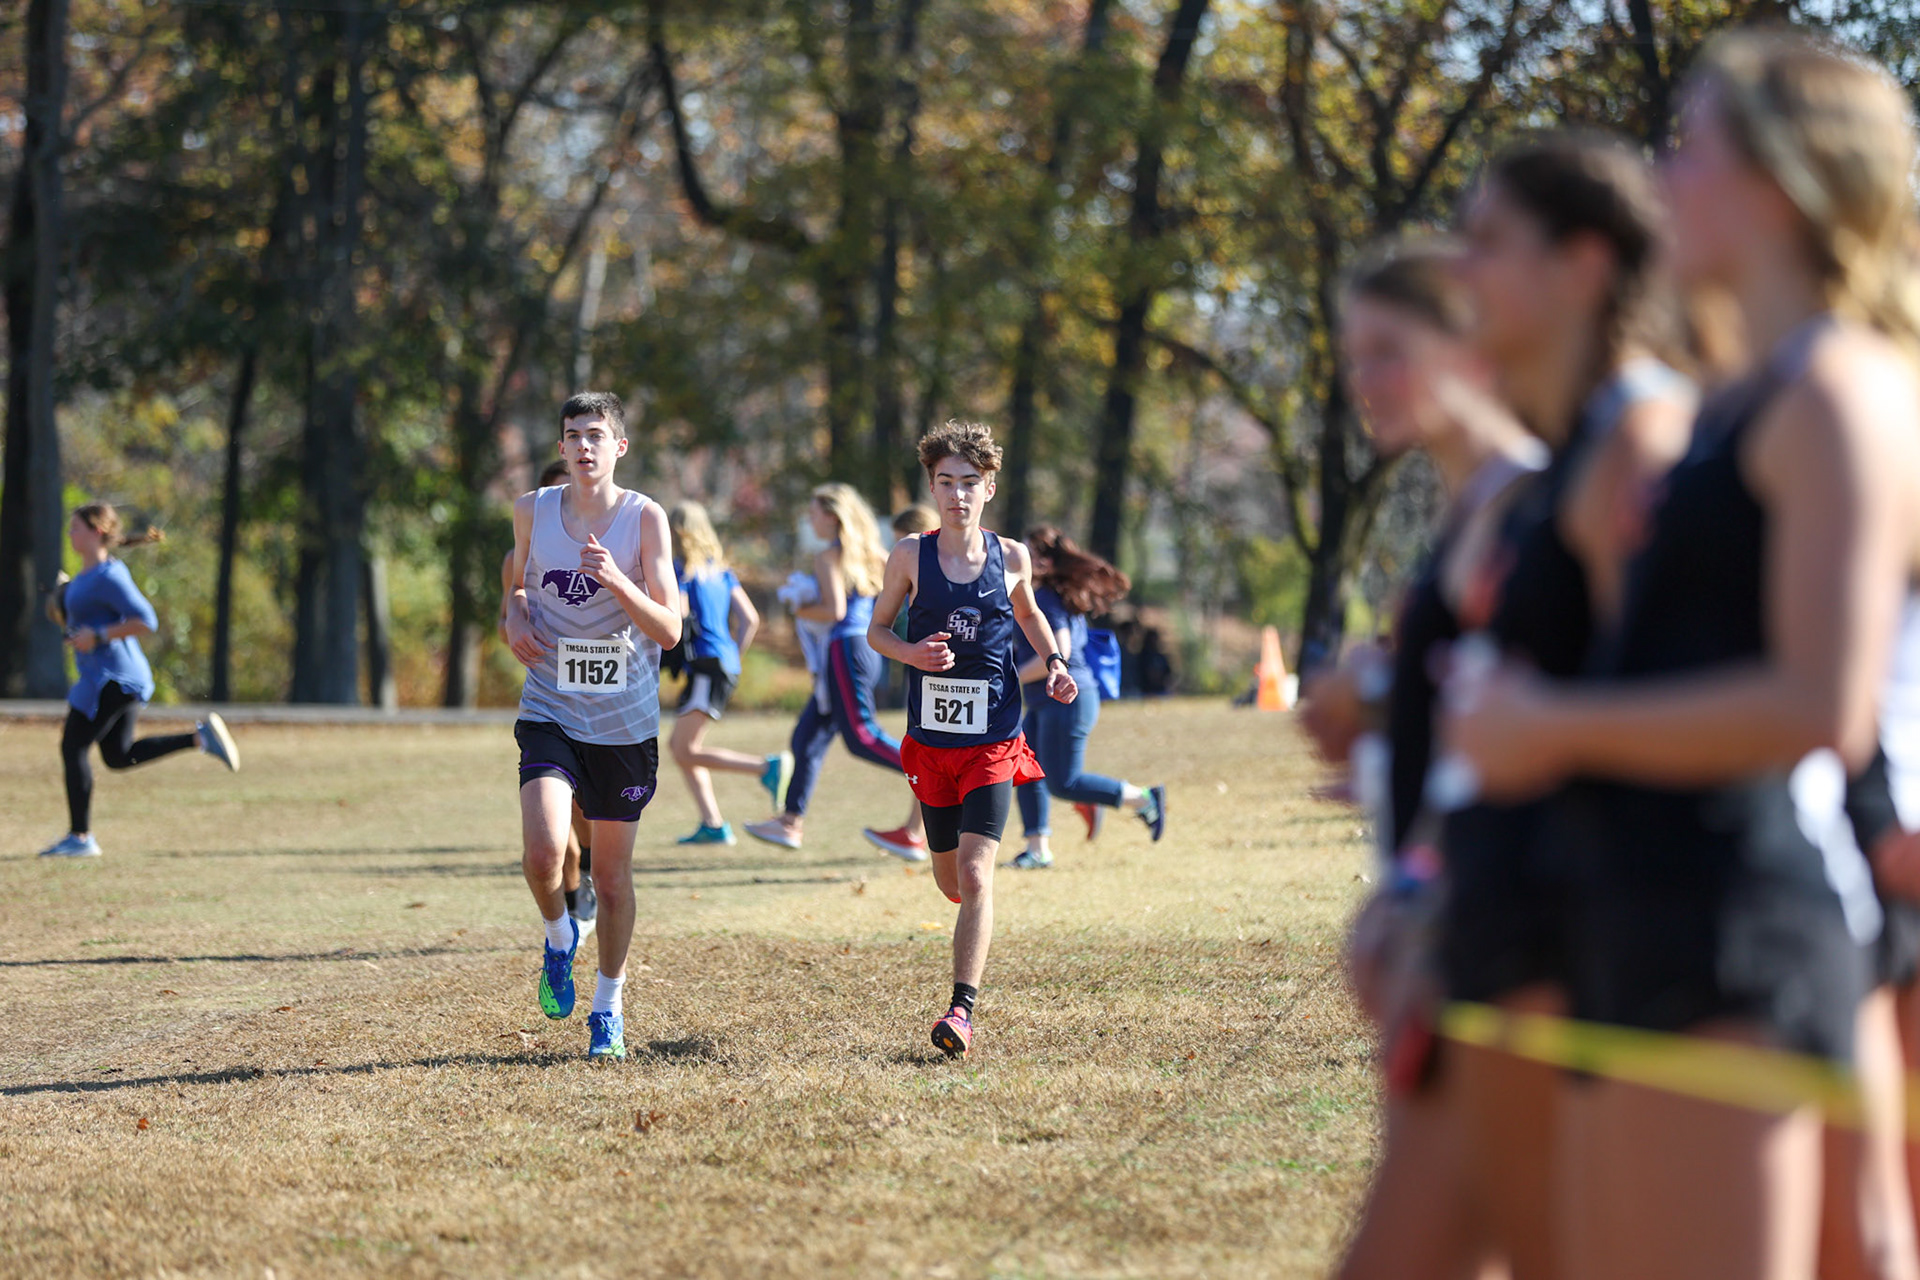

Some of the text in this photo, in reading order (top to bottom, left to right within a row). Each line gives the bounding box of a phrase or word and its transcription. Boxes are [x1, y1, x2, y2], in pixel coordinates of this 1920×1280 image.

[565, 571, 592, 596] LA
[949, 614, 976, 640] SBA
[565, 644, 620, 654] TMSAA STATE XC
[565, 659, 619, 685] 1152
[929, 683, 981, 694] TSSAA STATE XC
[934, 697, 974, 725] 521
